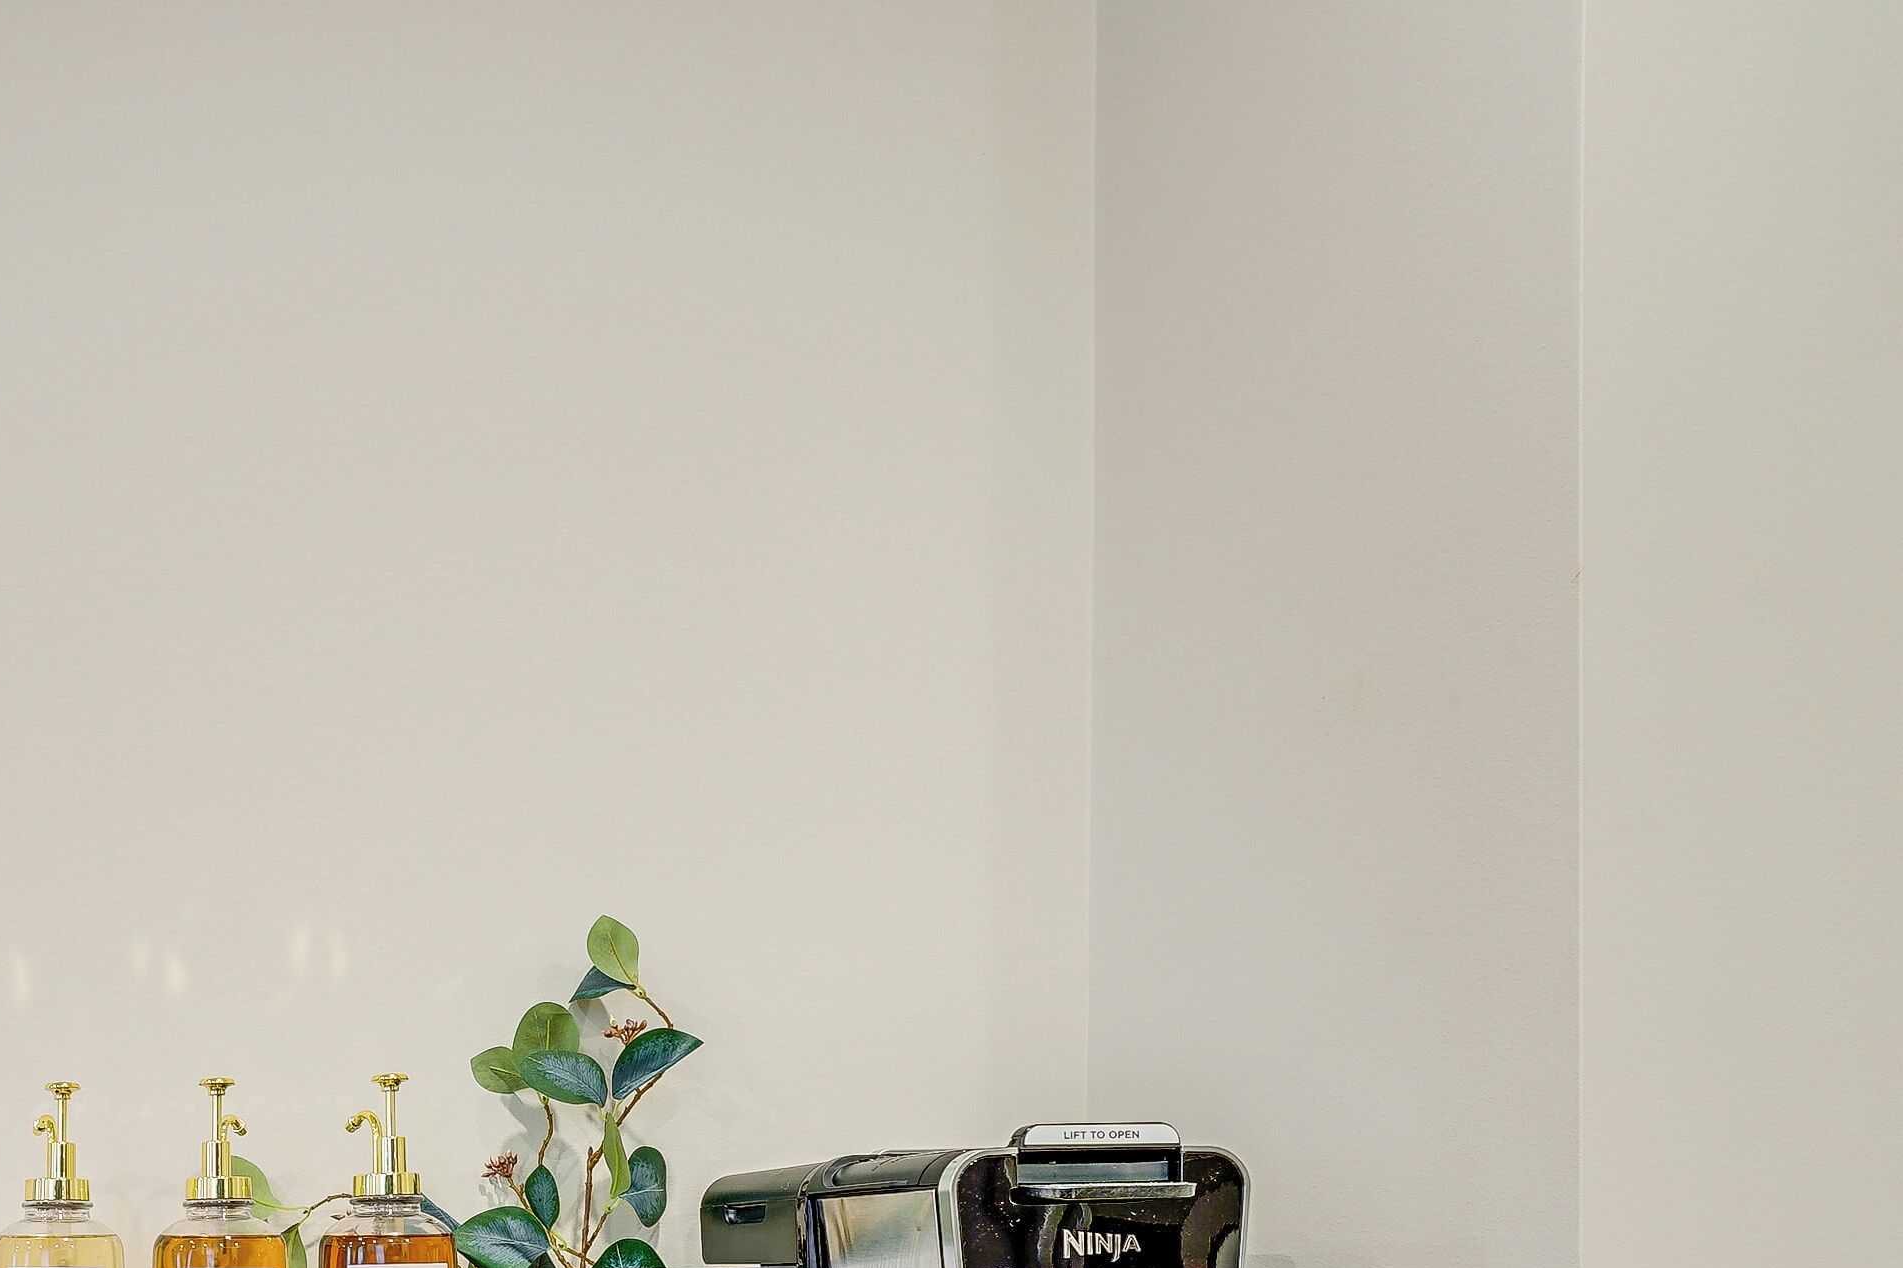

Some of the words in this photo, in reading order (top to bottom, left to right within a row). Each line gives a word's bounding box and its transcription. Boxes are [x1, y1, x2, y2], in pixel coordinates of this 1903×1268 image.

[1063, 1131, 1086, 1140] LIFT
[1090, 1131, 1106, 1139] TO
[1108, 1130, 1140, 1139] OPEN
[1062, 1228, 1142, 1263] NINJA
